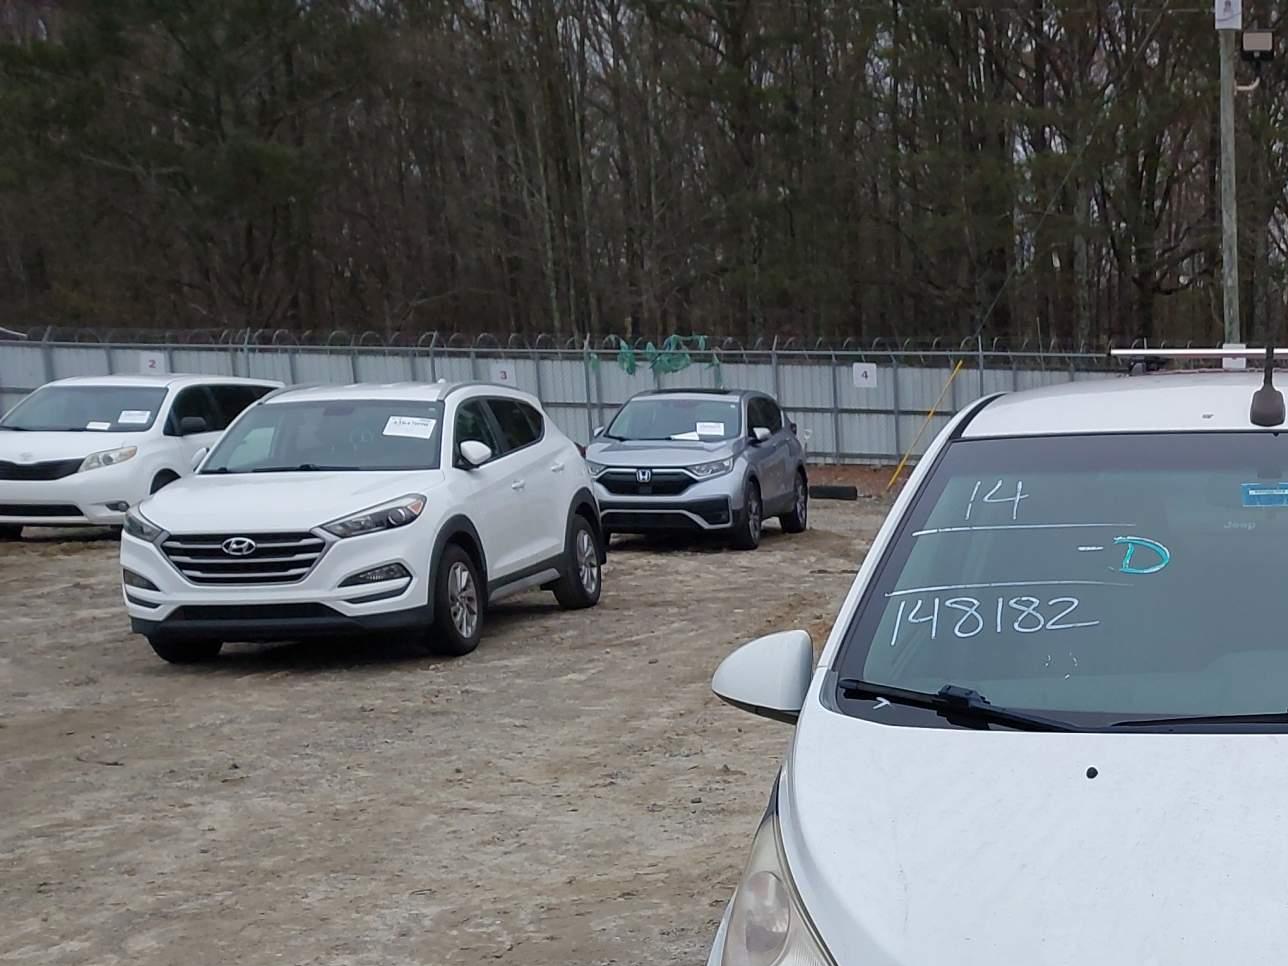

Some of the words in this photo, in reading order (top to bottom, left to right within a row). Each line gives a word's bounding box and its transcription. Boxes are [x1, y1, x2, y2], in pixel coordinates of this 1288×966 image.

[148, 359, 157, 369] 2
[499, 370, 508, 380] 3
[861, 370, 869, 380] 4
[966, 480, 1030, 520] 14
[891, 597, 1100, 645] 148182
